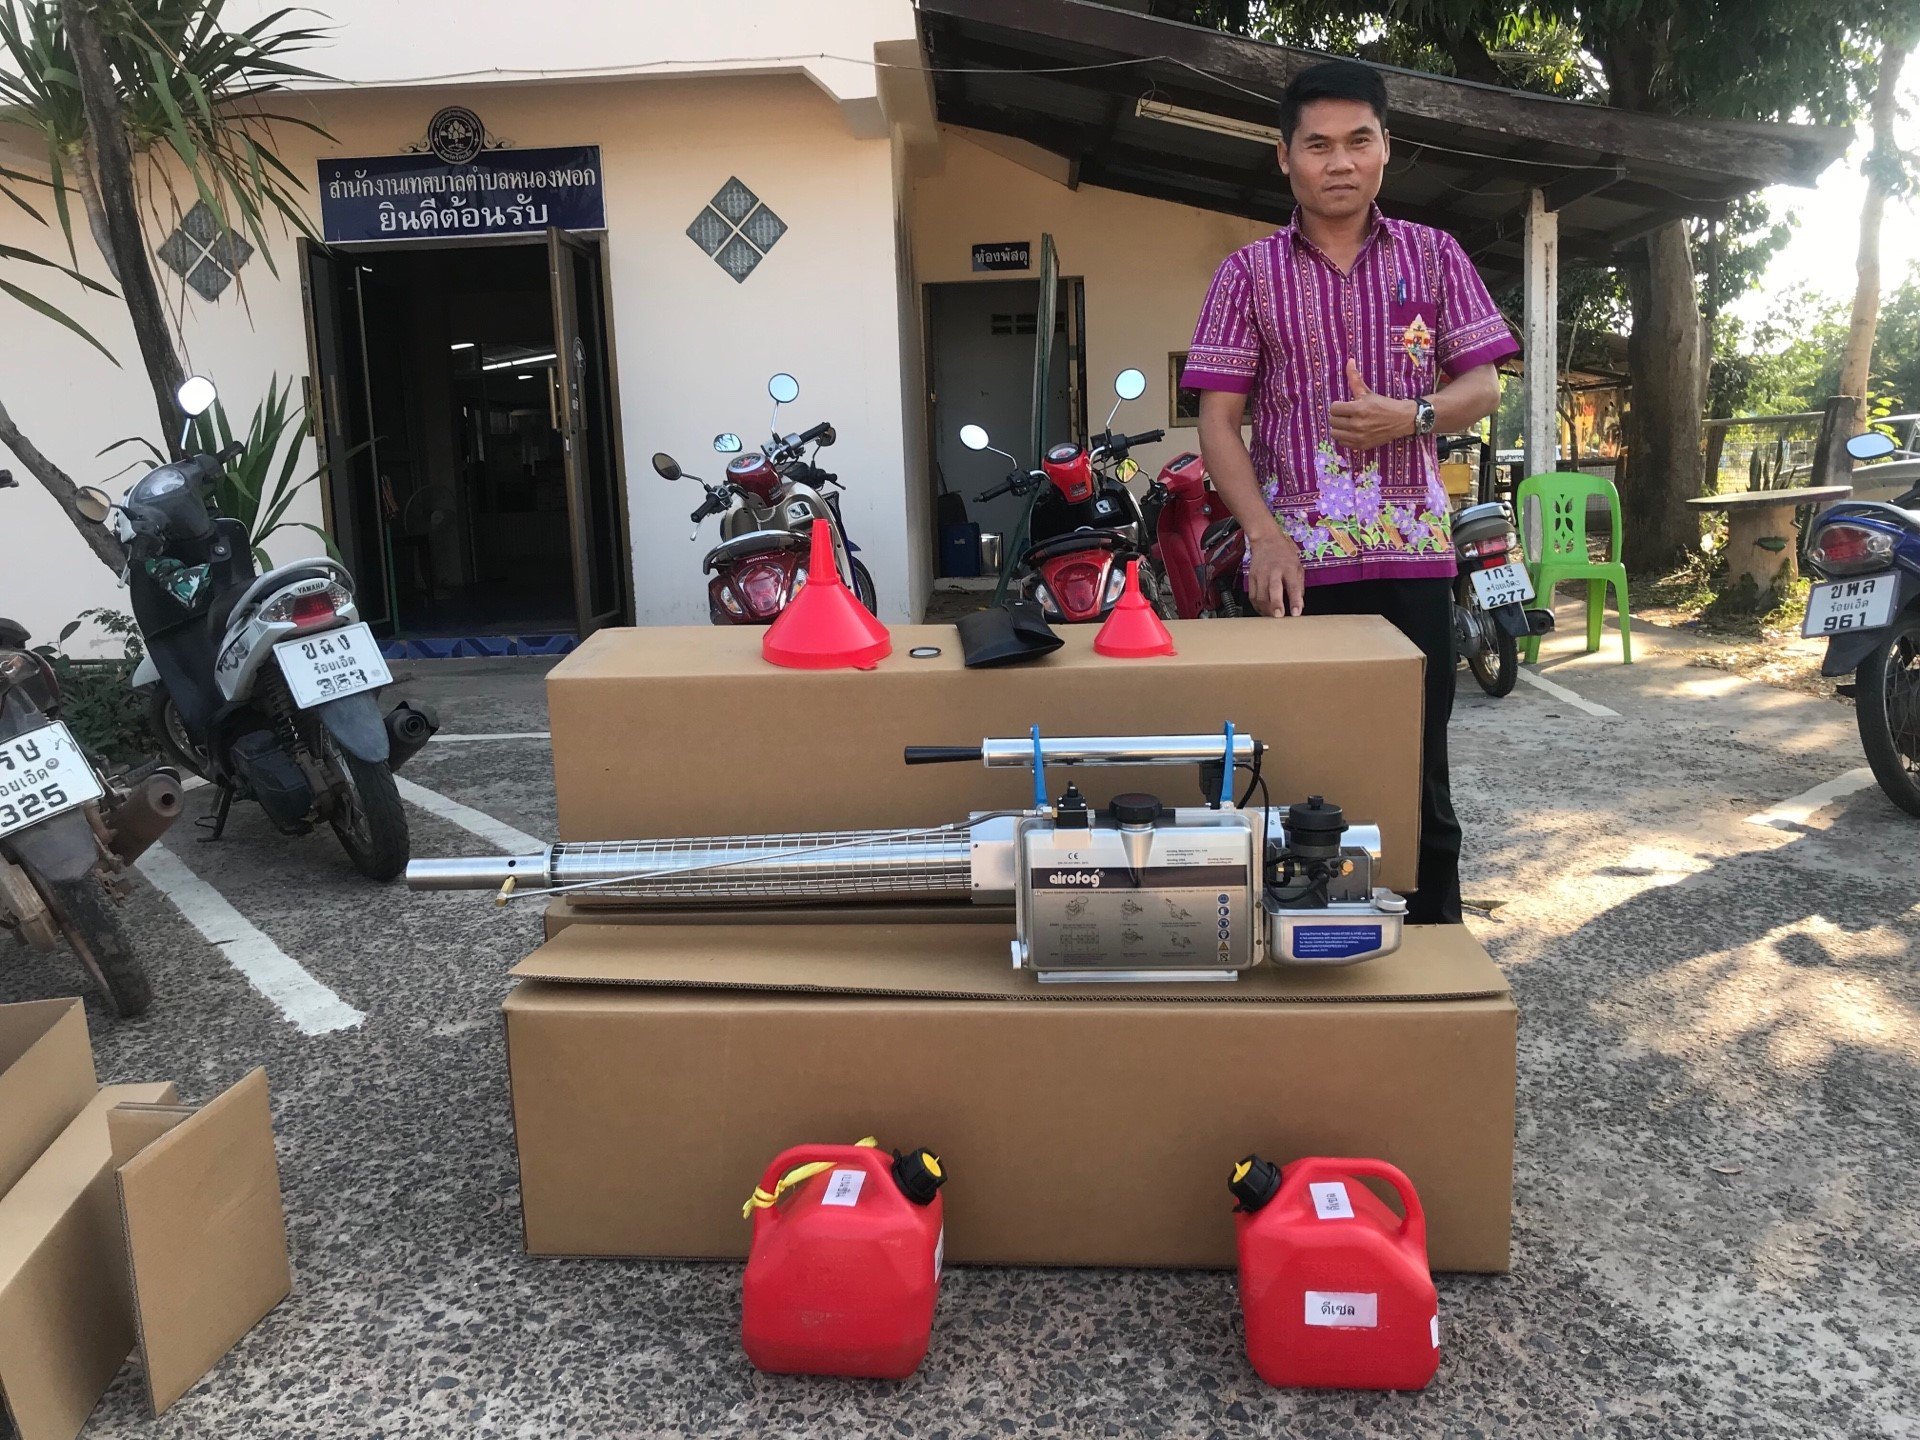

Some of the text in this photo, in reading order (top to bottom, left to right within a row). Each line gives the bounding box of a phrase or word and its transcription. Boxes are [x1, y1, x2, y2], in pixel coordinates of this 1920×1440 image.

[328, 165, 596, 199] สำนักงานเทศบาลตำบลหนองพอก
[379, 194, 549, 232] ยินดีต้อนรับ
[975, 246, 1028, 266] ห้องพัสดุ
[297, 582, 325, 594] YAMAHA
[1487, 588, 1526, 607] 2277
[1830, 599, 1869, 613] ร้อยเอ็ด
[1823, 612, 1867, 631] 961
[313, 654, 357, 675] ร้อยเอ็ด
[0, 782, 68, 828] 325
[1321, 1301, 1355, 1316] ดีเซล
